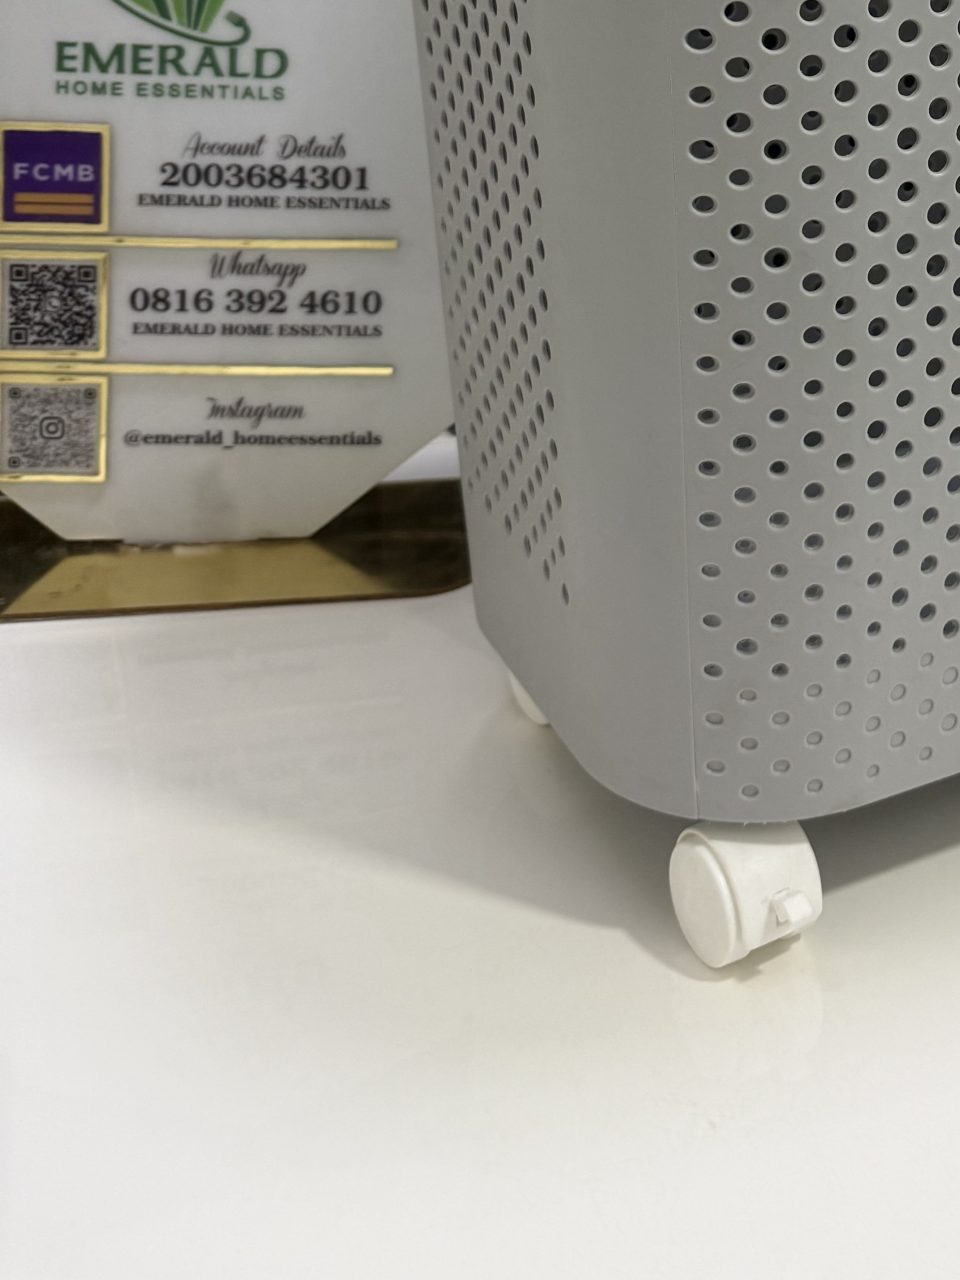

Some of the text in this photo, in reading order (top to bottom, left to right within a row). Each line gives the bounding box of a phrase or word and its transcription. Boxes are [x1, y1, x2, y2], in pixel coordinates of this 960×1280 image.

[55, 41, 289, 79] EMERALD
[55, 80, 286, 101] HOME ESSENTIALS
[181, 132, 347, 160] Account Details
[12, 163, 95, 182] FCMB
[160, 163, 370, 190] 2003684301
[138, 193, 391, 211] EMERALD HOME ESSENTIALS
[209, 251, 307, 288] Whatsapp
[129, 288, 383, 315] 0816 392 4610
[132, 323, 383, 338] EMERALD HOME ESSENTIALS
[206, 396, 306, 429] Instagram
[124, 430, 382, 449] @emerald_homeessentials
